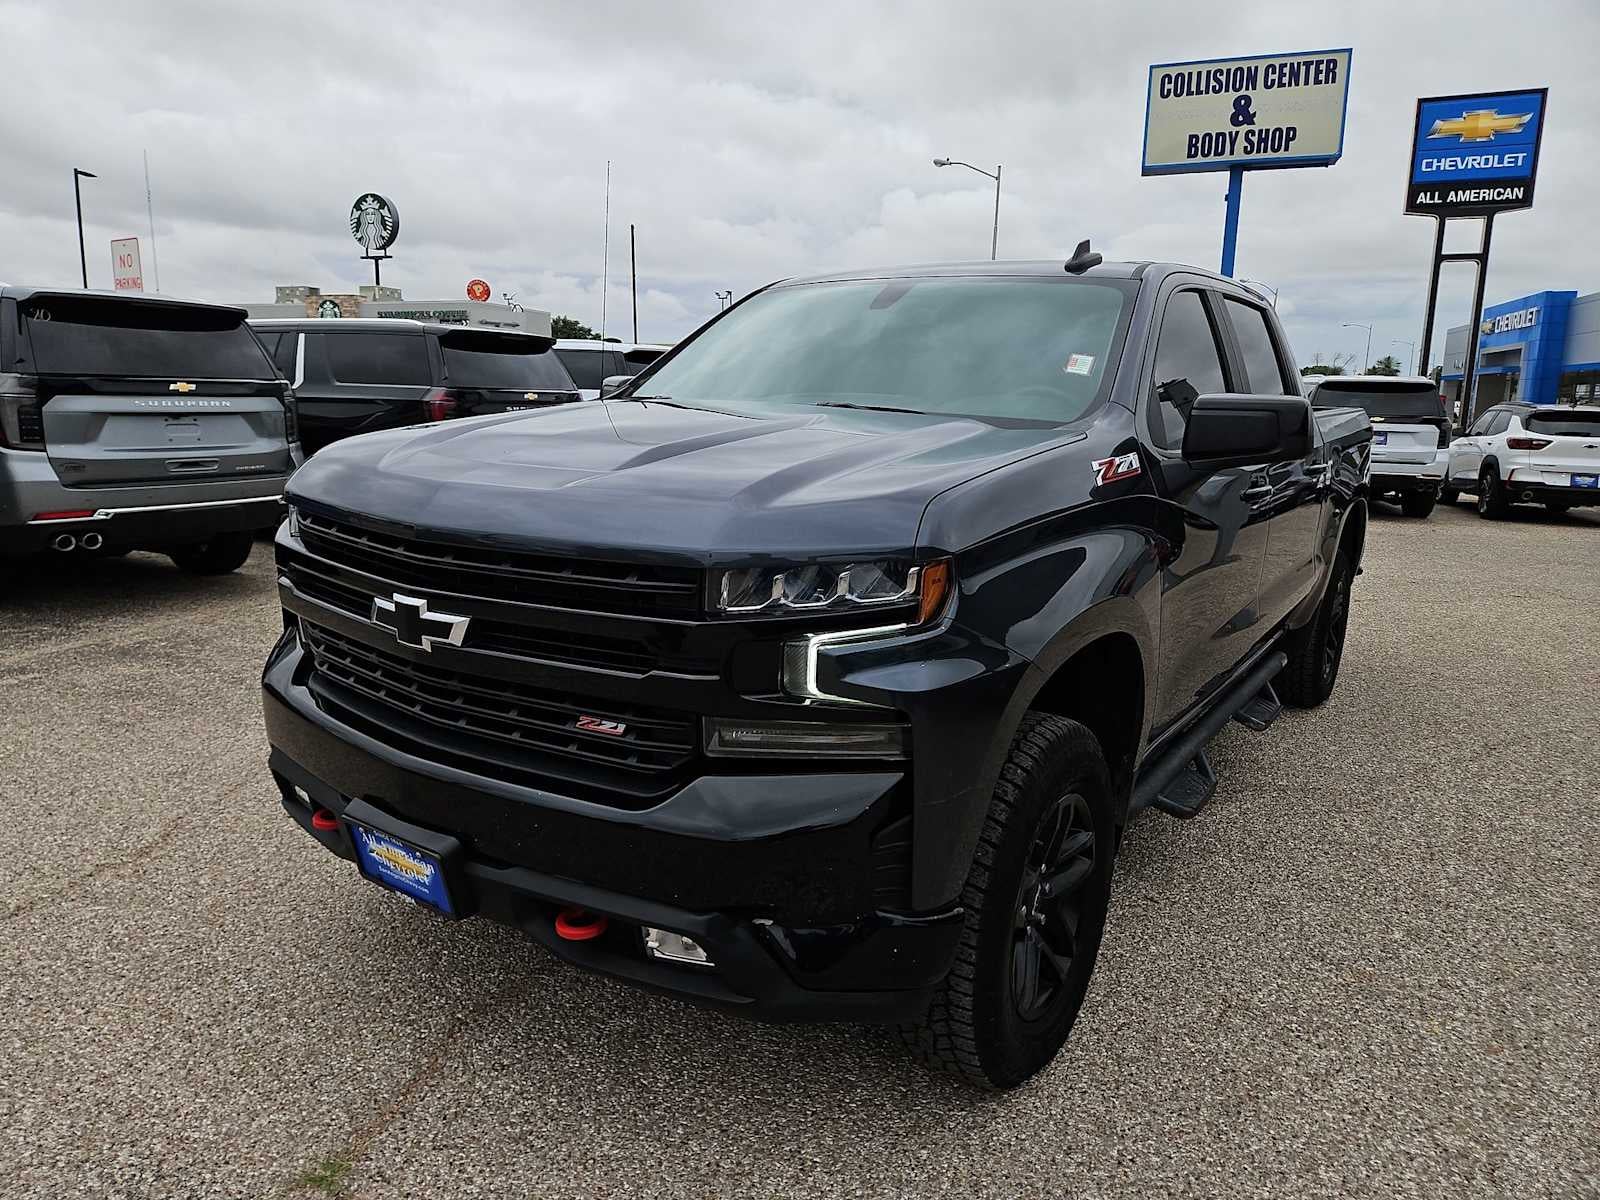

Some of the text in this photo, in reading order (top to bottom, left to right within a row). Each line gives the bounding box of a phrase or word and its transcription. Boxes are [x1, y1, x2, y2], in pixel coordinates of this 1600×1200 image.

[1160, 58, 1338, 99] COLLISION CENTER
[1230, 95, 1257, 127] &
[1187, 127, 1297, 159] BODY SHOP
[1421, 153, 1527, 172] CHEVROLET
[1416, 187, 1524, 204] ALL AMERICAN
[119, 253, 133, 268] NO
[1494, 307, 1537, 333] CHEVROLET
[1091, 451, 1141, 487] Z71
[576, 715, 626, 735] Z71
